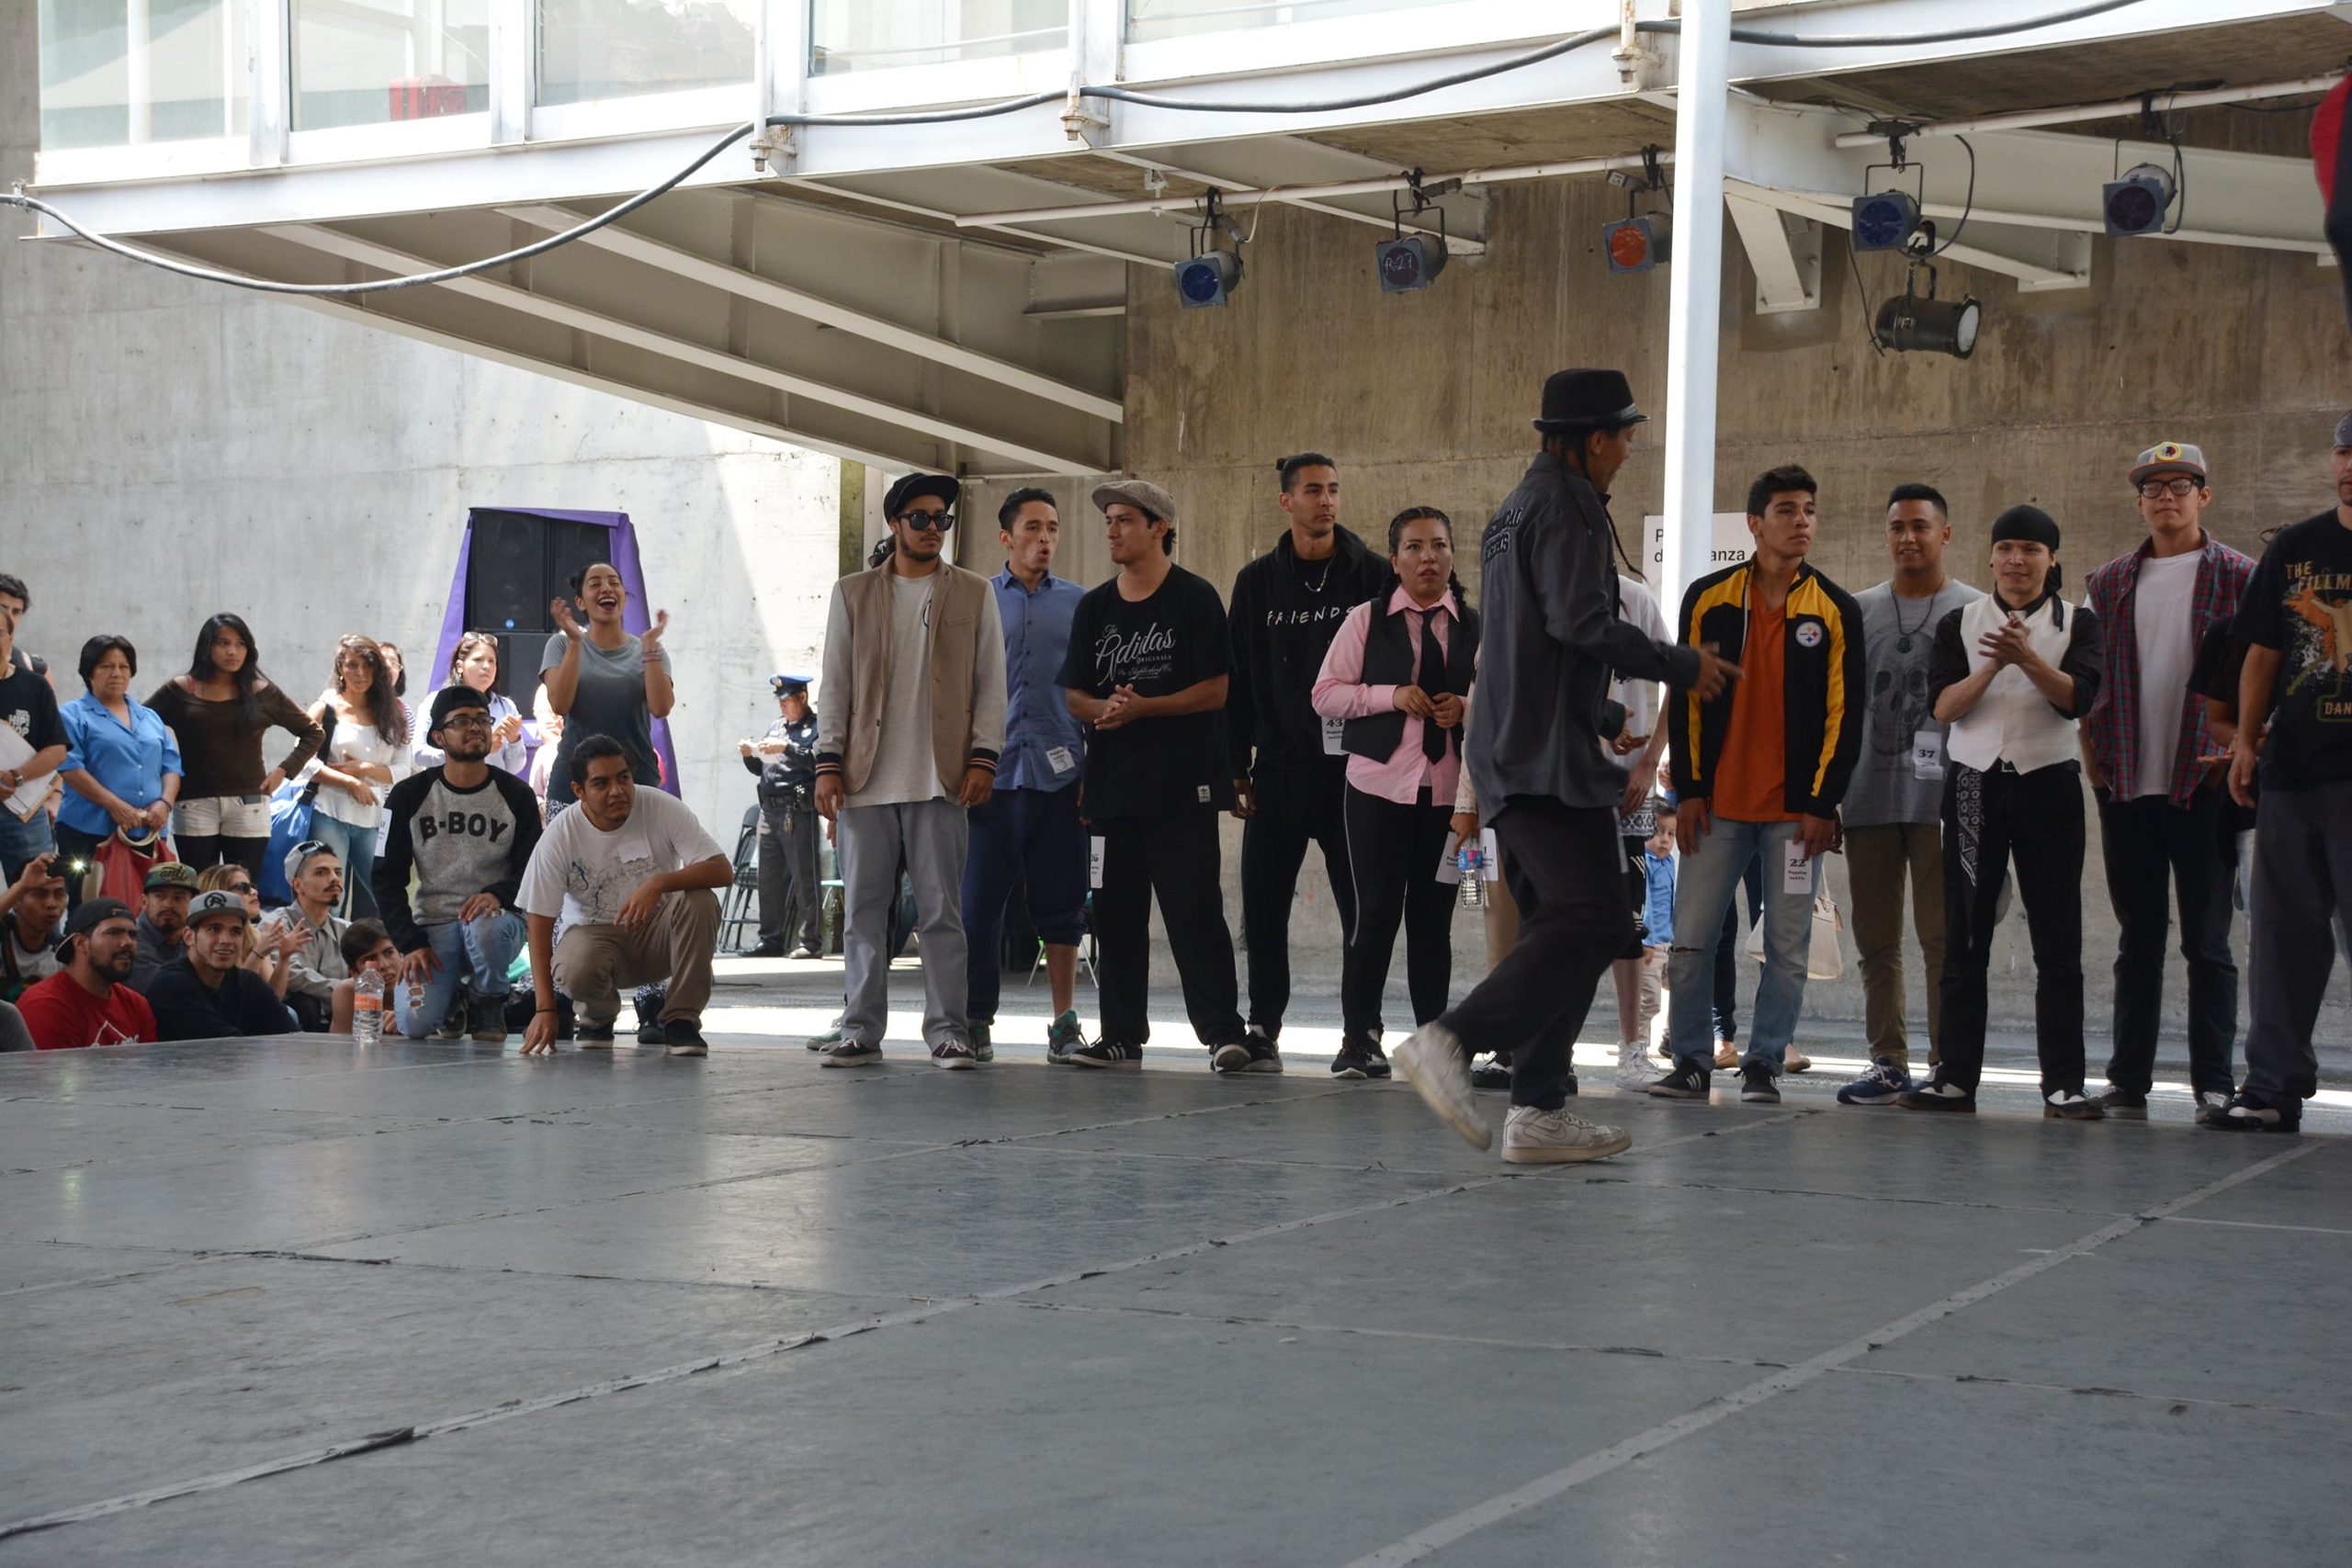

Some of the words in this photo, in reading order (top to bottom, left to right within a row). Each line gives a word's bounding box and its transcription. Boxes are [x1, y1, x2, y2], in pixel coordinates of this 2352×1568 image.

[1711, 549, 1746, 561] anza
[2285, 561, 2312, 580] THE
[2298, 573, 2352, 592] FILLM
[1095, 623, 1176, 686] Adidas
[1136, 654, 1172, 664] ORIGINALS
[2324, 702, 2352, 716] DAN
[1917, 749, 1936, 760] 37
[419, 811, 508, 843] B-BOY
[1789, 858, 1806, 868] 22
